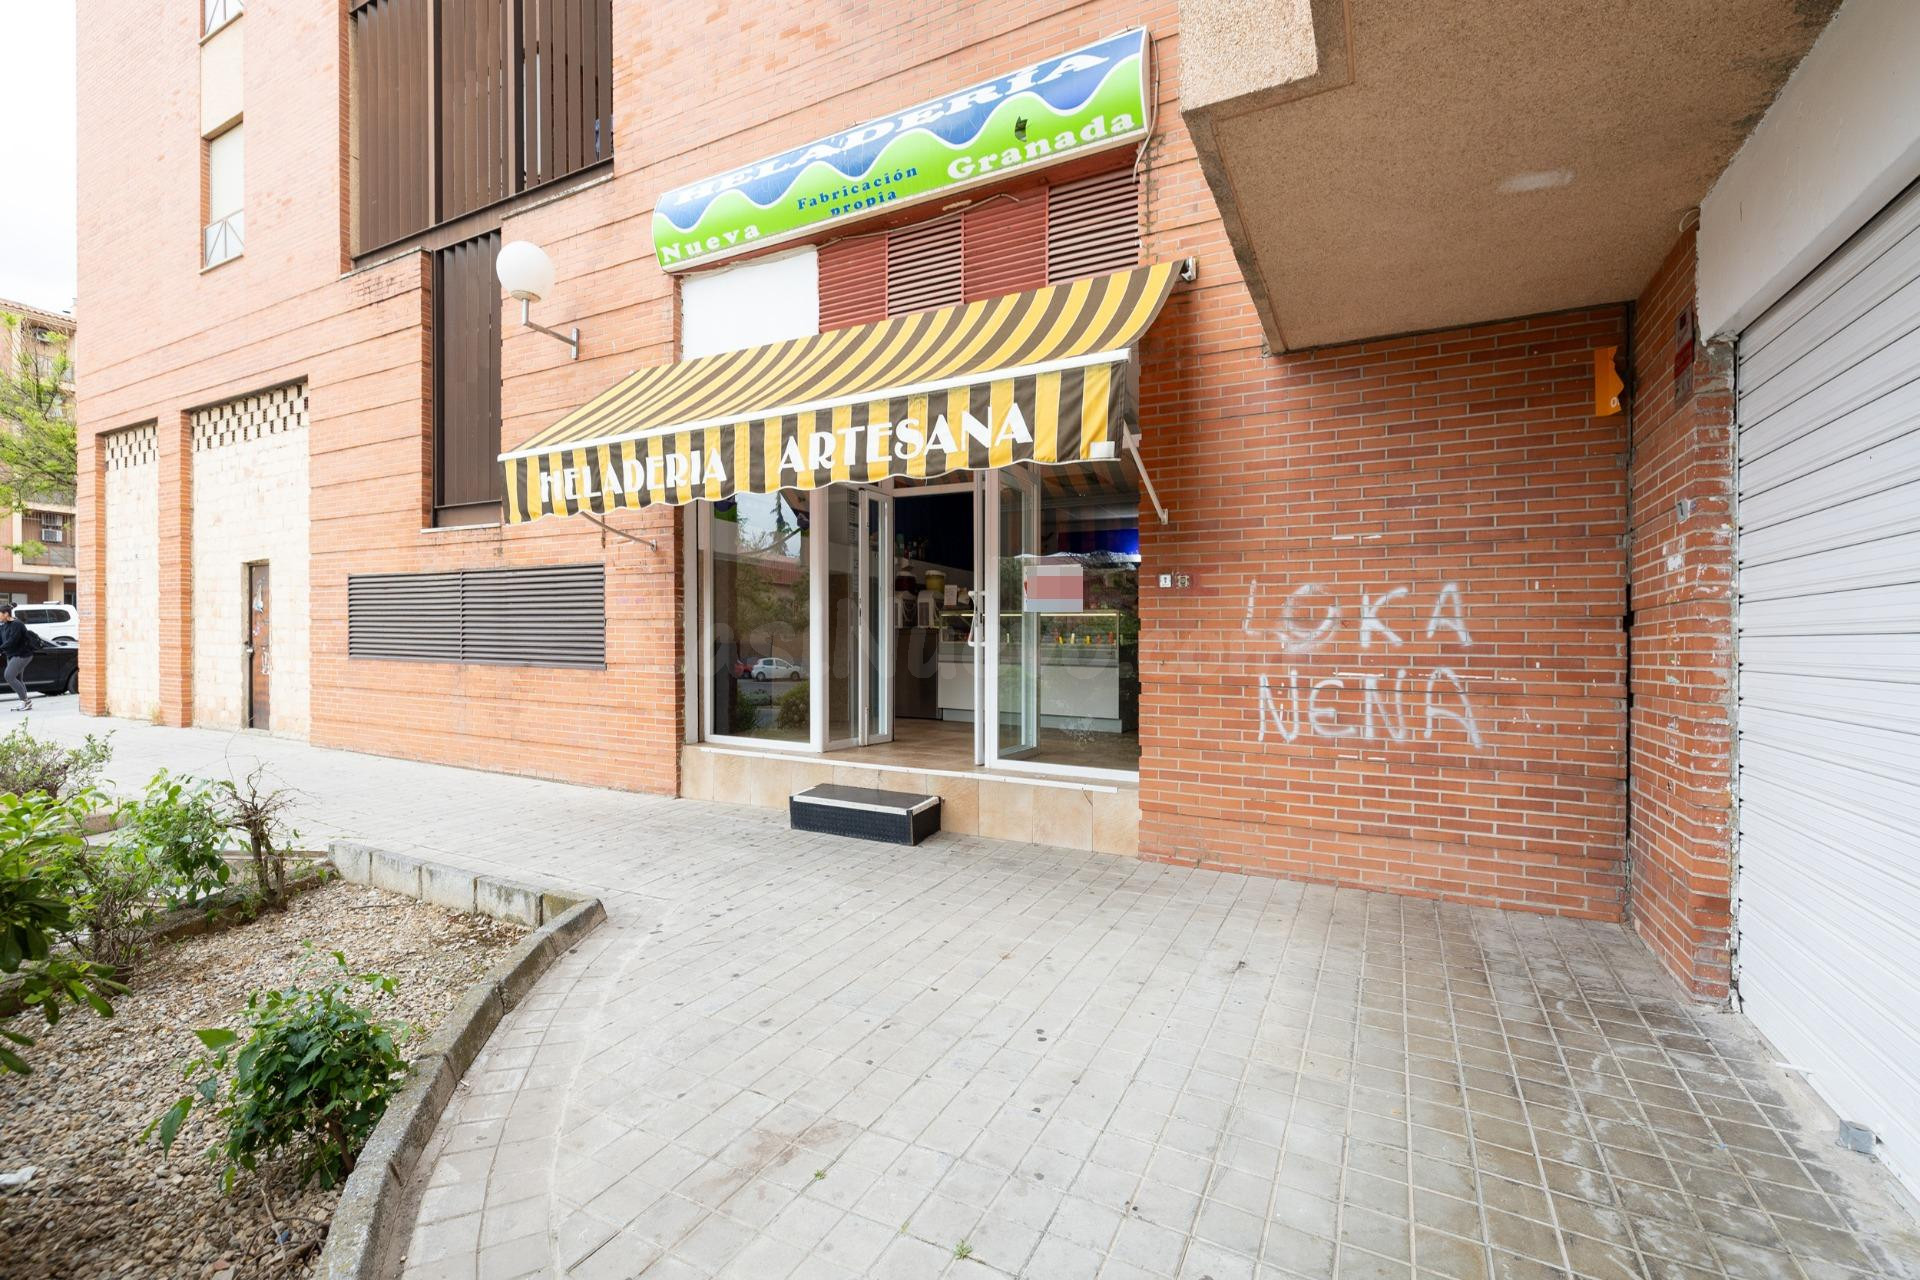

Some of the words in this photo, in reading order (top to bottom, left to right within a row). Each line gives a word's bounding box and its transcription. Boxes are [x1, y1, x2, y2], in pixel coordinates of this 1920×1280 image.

[660, 223, 760, 263] Nueva
[947, 112, 1135, 179] Granada
[797, 166, 918, 210] Fabricación
[830, 190, 897, 217] propia
[540, 448, 728, 503] HELADERIA
[777, 402, 1034, 475] ARTESANA
[1242, 578, 1473, 651] LOKA
[1257, 666, 1483, 749] NENA
